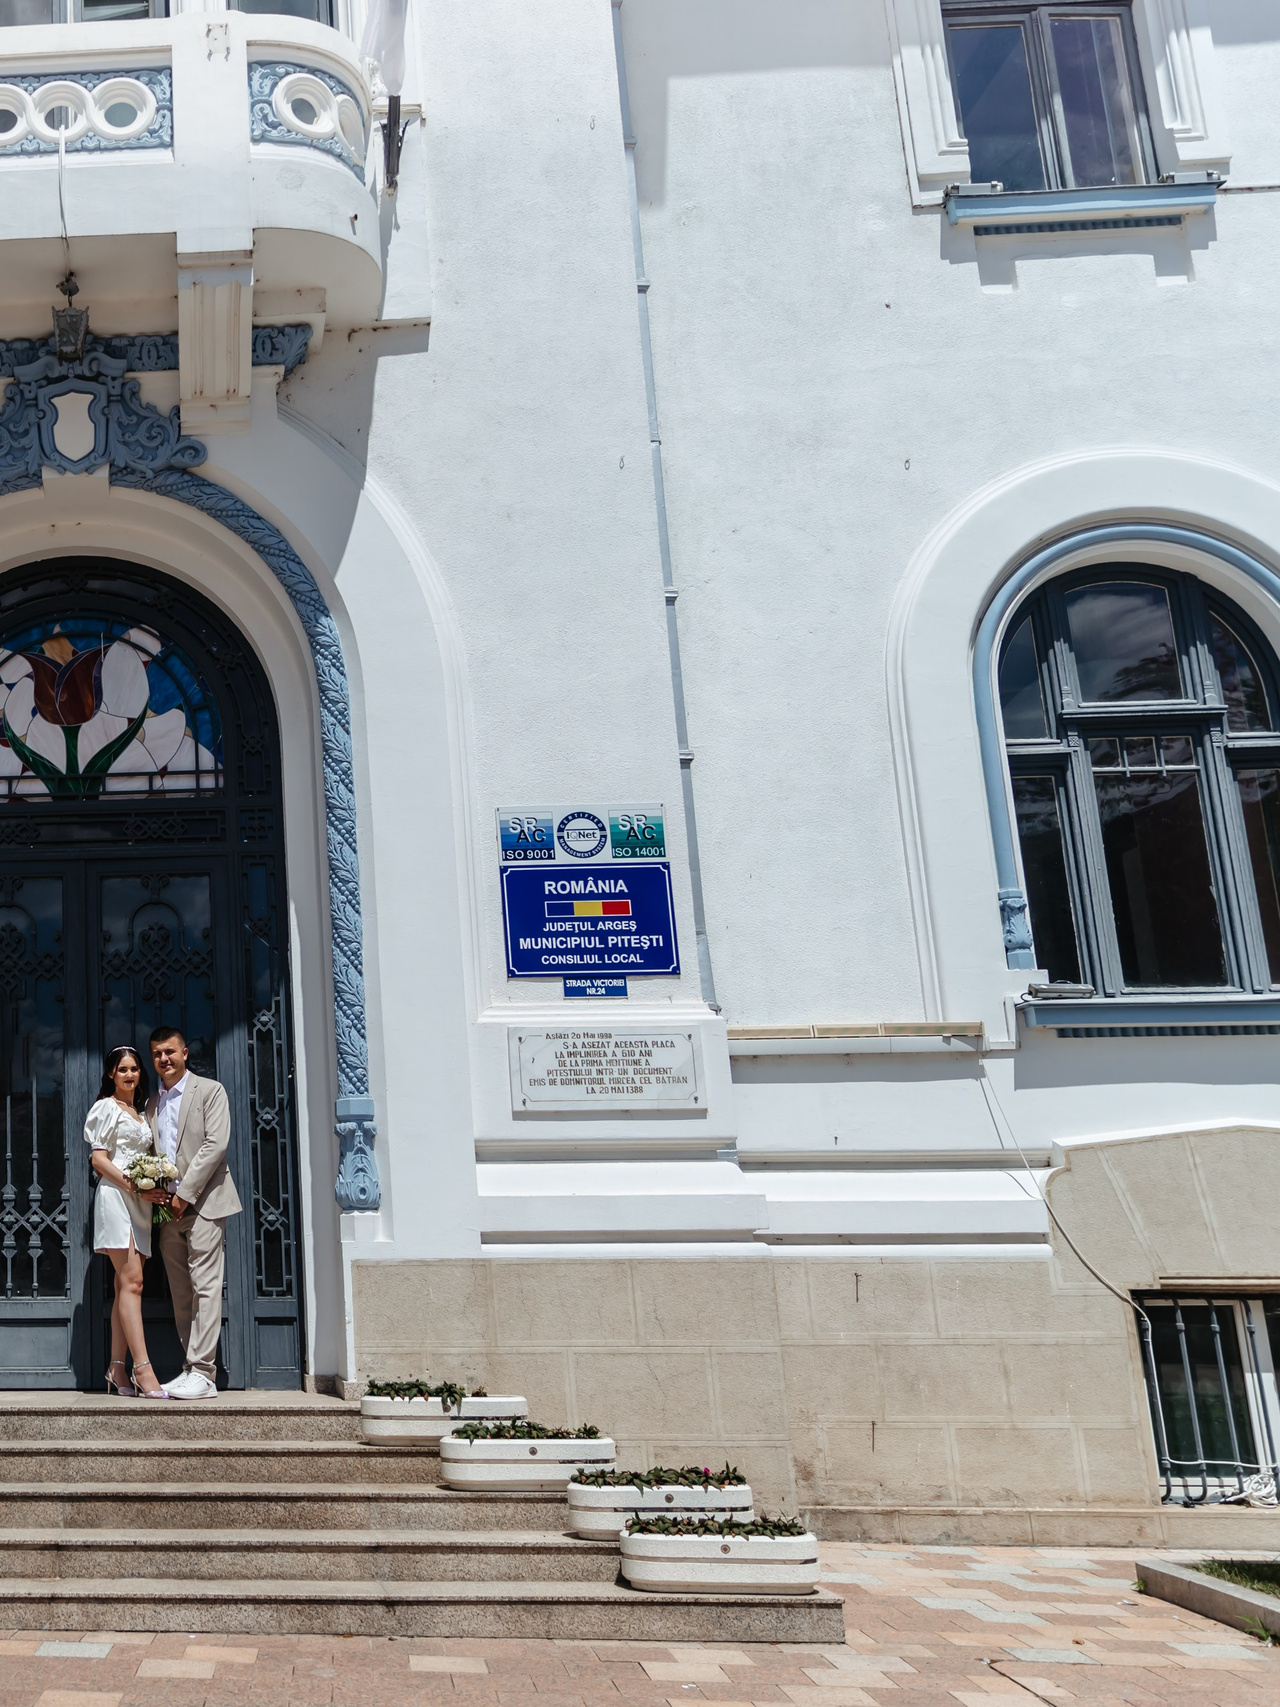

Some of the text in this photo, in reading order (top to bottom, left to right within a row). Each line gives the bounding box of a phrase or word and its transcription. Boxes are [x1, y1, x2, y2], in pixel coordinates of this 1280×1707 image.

[560, 813, 602, 828] CERTIFIED
[566, 830, 598, 840] IQNet
[560, 837, 606, 857] MANAGEMENT SYSTEM
[612, 847, 664, 857] ISO 14001
[502, 849, 554, 859] ISO 9001
[544, 876, 628, 895] ROMÂNIA
[519, 937, 604, 950] MUNICIPIUL
[541, 954, 644, 965] CONSILIUL LOCAL
[593, 979, 625, 987] VICTORIEI
[563, 1041, 578, 1049] S-A
[639, 1049, 652, 1057] ANI
[633, 1067, 673, 1076] DOCUMENT
[549, 1078, 557, 1086] DE
[560, 1077, 606, 1086] DOMNITORUL
[639, 1076, 652, 1084] CEL
